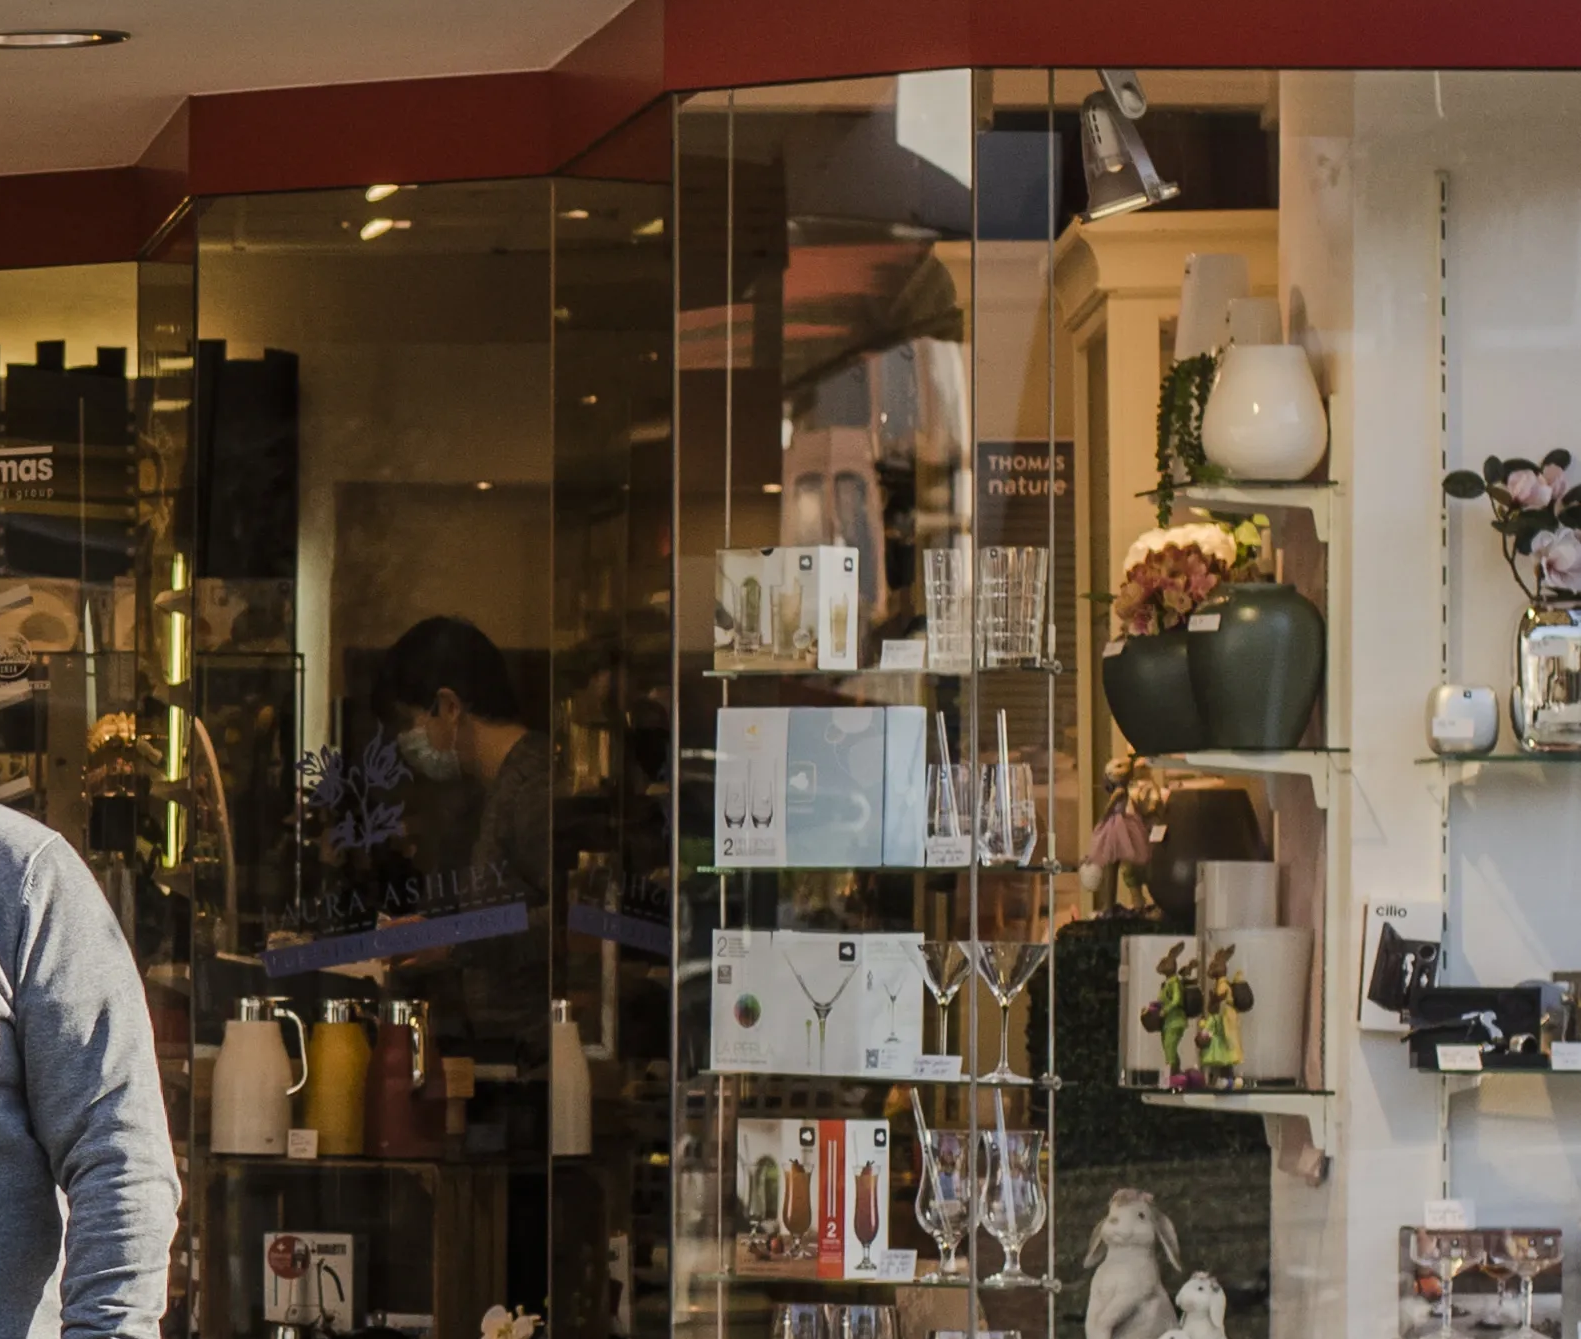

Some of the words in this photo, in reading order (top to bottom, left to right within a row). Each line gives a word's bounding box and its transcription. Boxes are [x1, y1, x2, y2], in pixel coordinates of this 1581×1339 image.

[16, 486, 55, 501] group
[987, 476, 1068, 496] nature
[723, 837, 734, 857] 2
[261, 890, 366, 929] LAURA
[382, 859, 509, 909] ASHLEY
[1375, 903, 1408, 919] cilio
[716, 936, 727, 958] 2
[827, 1222, 837, 1239] 2
